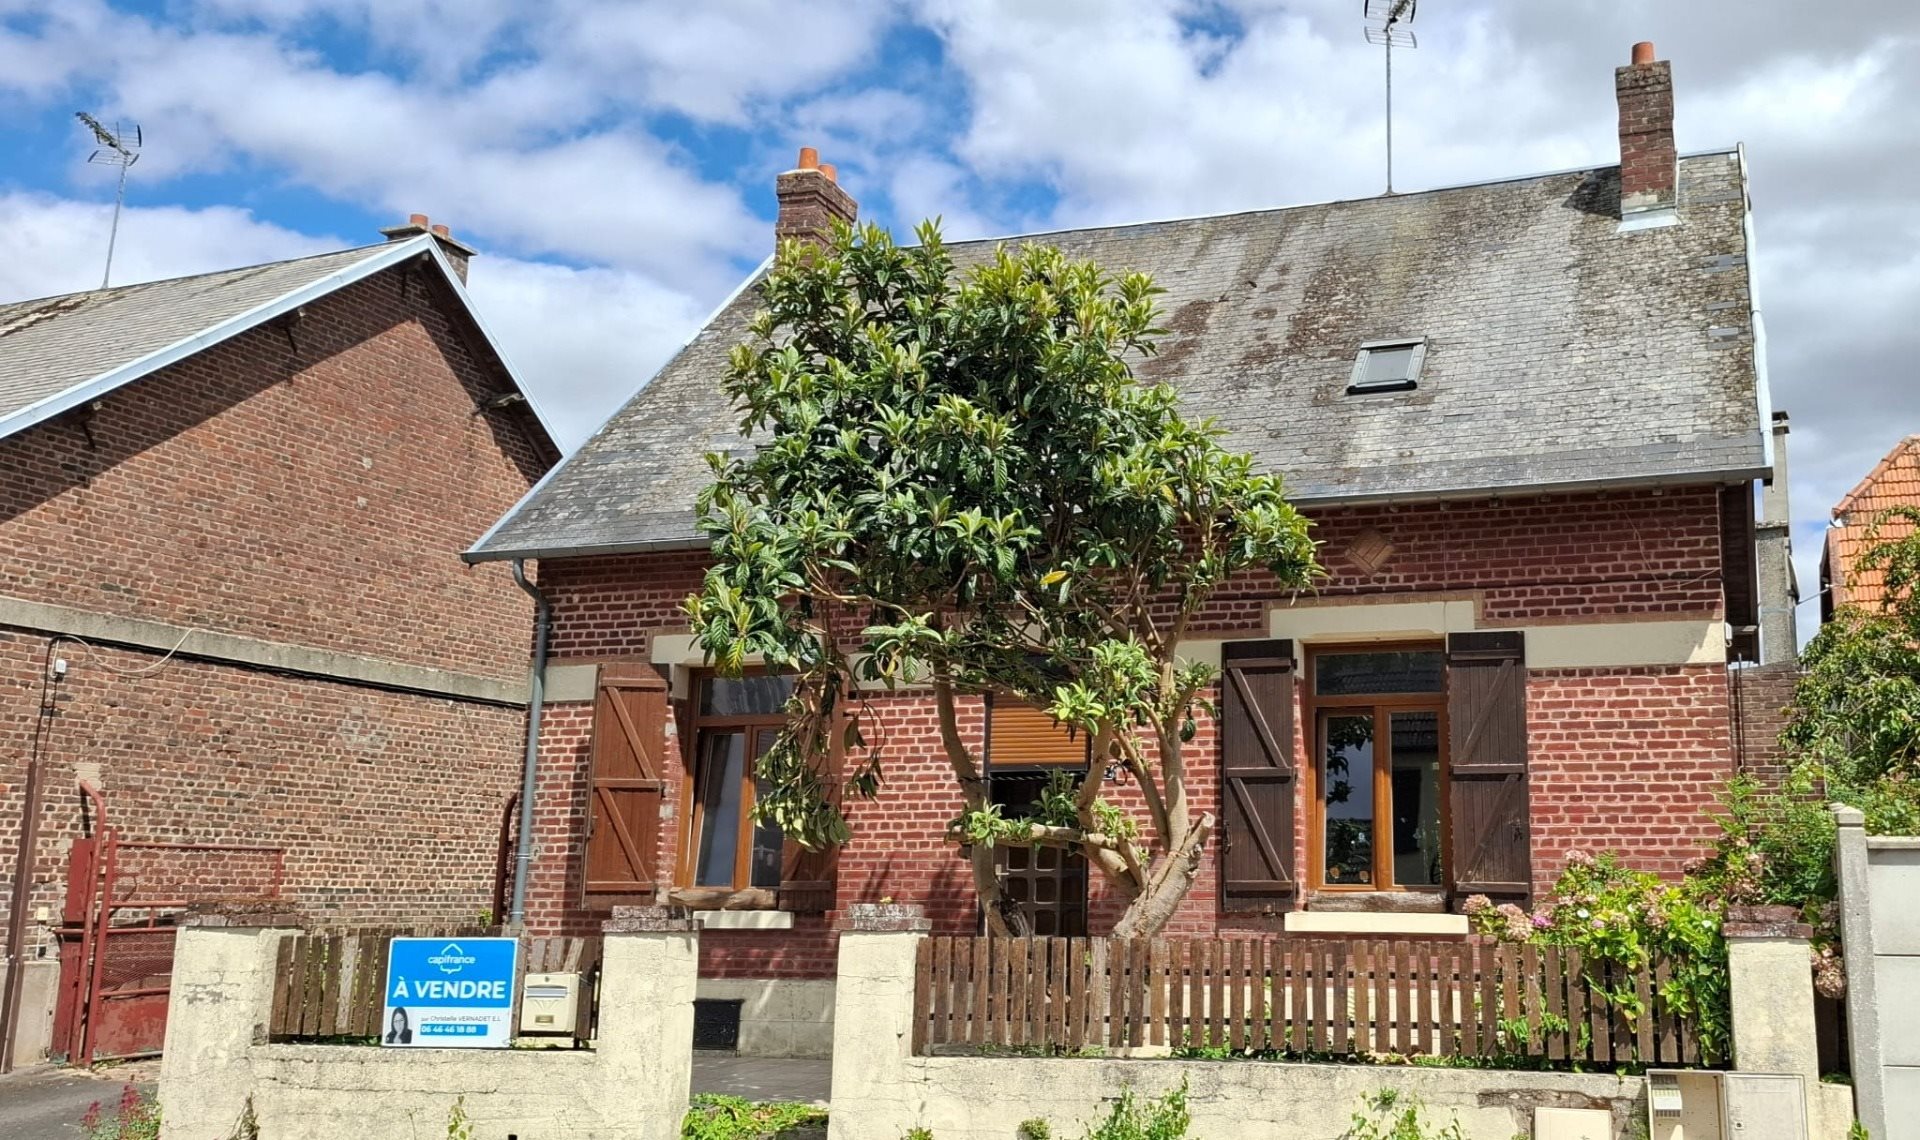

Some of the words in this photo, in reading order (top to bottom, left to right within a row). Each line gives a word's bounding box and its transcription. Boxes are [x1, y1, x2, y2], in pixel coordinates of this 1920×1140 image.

[428, 955, 476, 965] capifrance
[393, 976, 409, 999] À
[414, 980, 506, 999] VENDRE
[421, 1025, 431, 1033] 06
[433, 1025, 443, 1033] 46
[444, 1025, 455, 1033] 46
